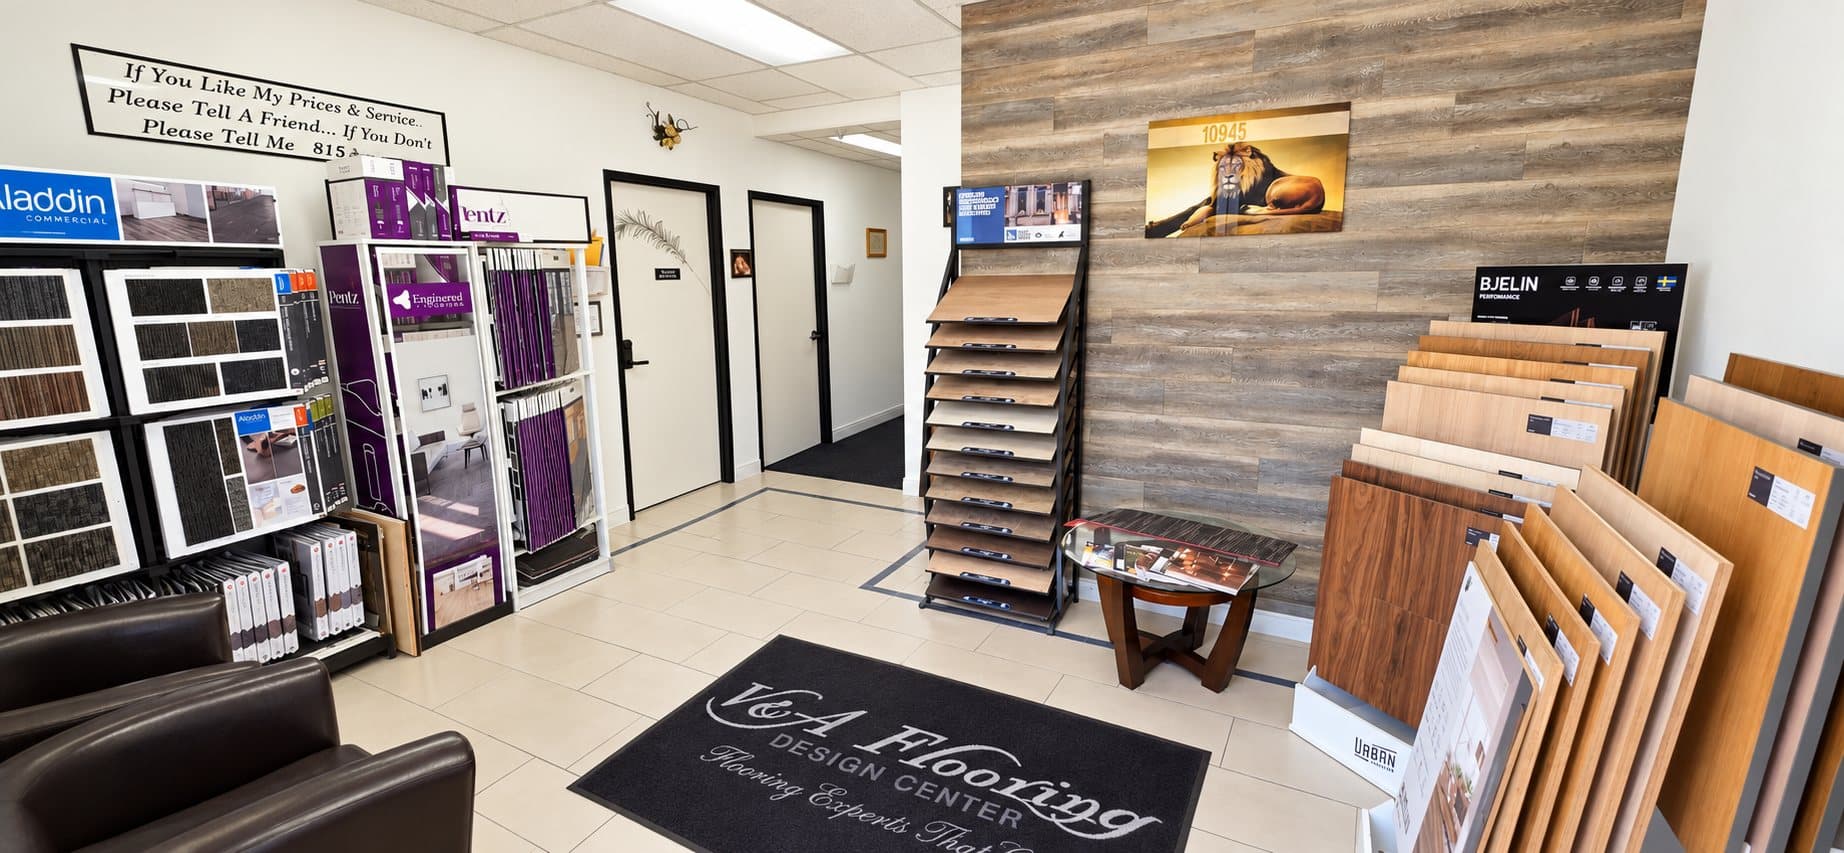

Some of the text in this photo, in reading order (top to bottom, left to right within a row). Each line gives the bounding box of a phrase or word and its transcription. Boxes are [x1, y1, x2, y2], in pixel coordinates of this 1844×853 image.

[123, 62, 146, 83] If
[151, 67, 193, 89] You
[200, 75, 246, 98] Like
[252, 85, 283, 106] My
[289, 92, 342, 114] Prices
[347, 103, 360, 117] &
[107, 87, 433, 150] Please Tell A Friend... If You Don't
[141, 118, 214, 141] Please
[221, 128, 259, 147] Tell
[266, 134, 295, 151] Me
[312, 141, 346, 158] 815
[1201, 122, 1248, 144] 10945
[25, 214, 108, 225] COMMERCIAL
[328, 290, 360, 305] Pentz
[1479, 276, 1539, 292] BJELIN
[705, 681, 1164, 841] V&A Flooring
[1354, 736, 1396, 769] URBAN
[699, 744, 805, 802] Flooring
[808, 782, 911, 834] Experts
[768, 732, 1024, 830] DESIGN CENTER
